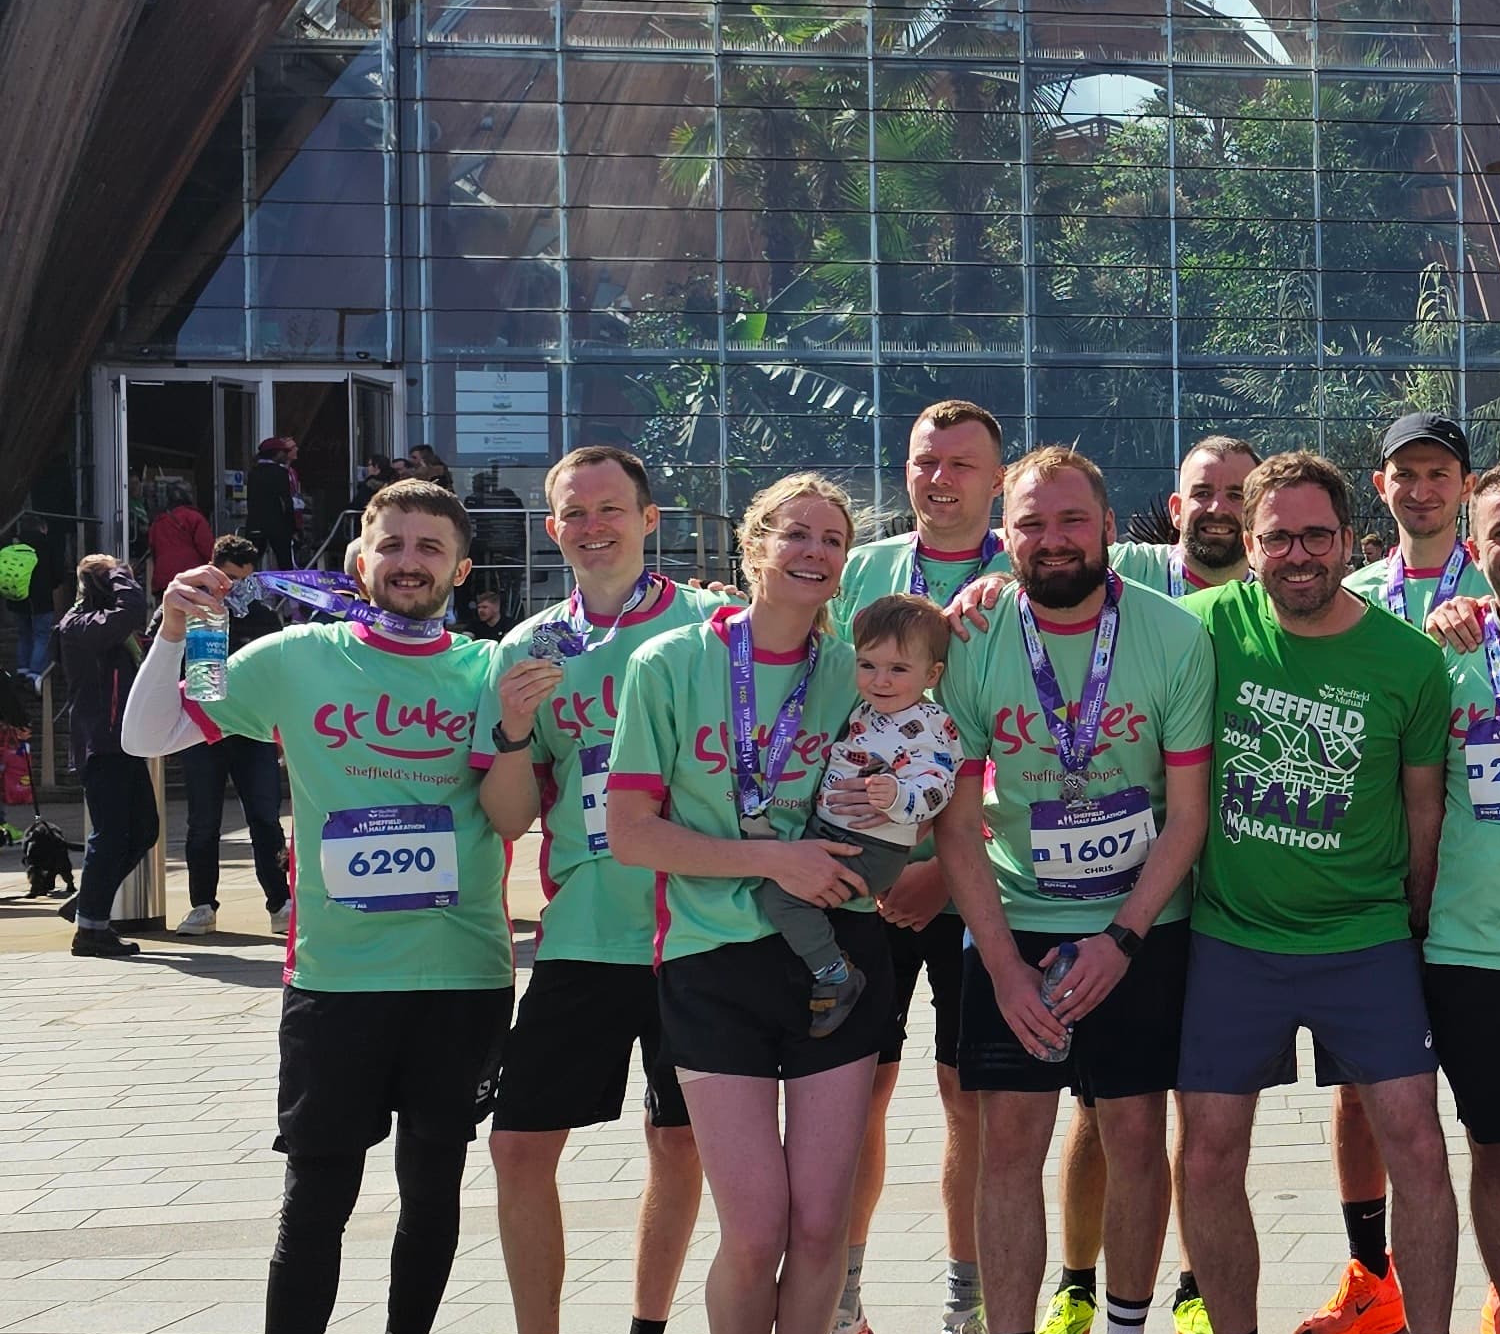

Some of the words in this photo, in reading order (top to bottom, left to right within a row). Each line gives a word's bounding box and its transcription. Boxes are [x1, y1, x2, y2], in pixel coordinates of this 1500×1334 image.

[1335, 695, 1364, 708] Mutual
[1336, 687, 1370, 702] Sheffield
[1236, 681, 1365, 735] SHEFFIELD
[1224, 711, 1263, 736] 13.1M
[1222, 728, 1261, 753] 2024
[345, 765, 410, 780] Sheffield's
[412, 771, 460, 786] Hospice
[1022, 770, 1064, 783] Sheffie
[1088, 767, 1123, 783] ospice
[1226, 768, 1353, 831] HALF
[368, 818, 402, 826] SHEFFIELD
[1073, 810, 1105, 819] SHEFFIELD
[1091, 809, 1127, 823] MARATHON
[1227, 808, 1342, 850] MARATHON
[1060, 828, 1136, 864] 1607
[348, 847, 436, 877] 6290
[1084, 864, 1114, 874] CHRIS
